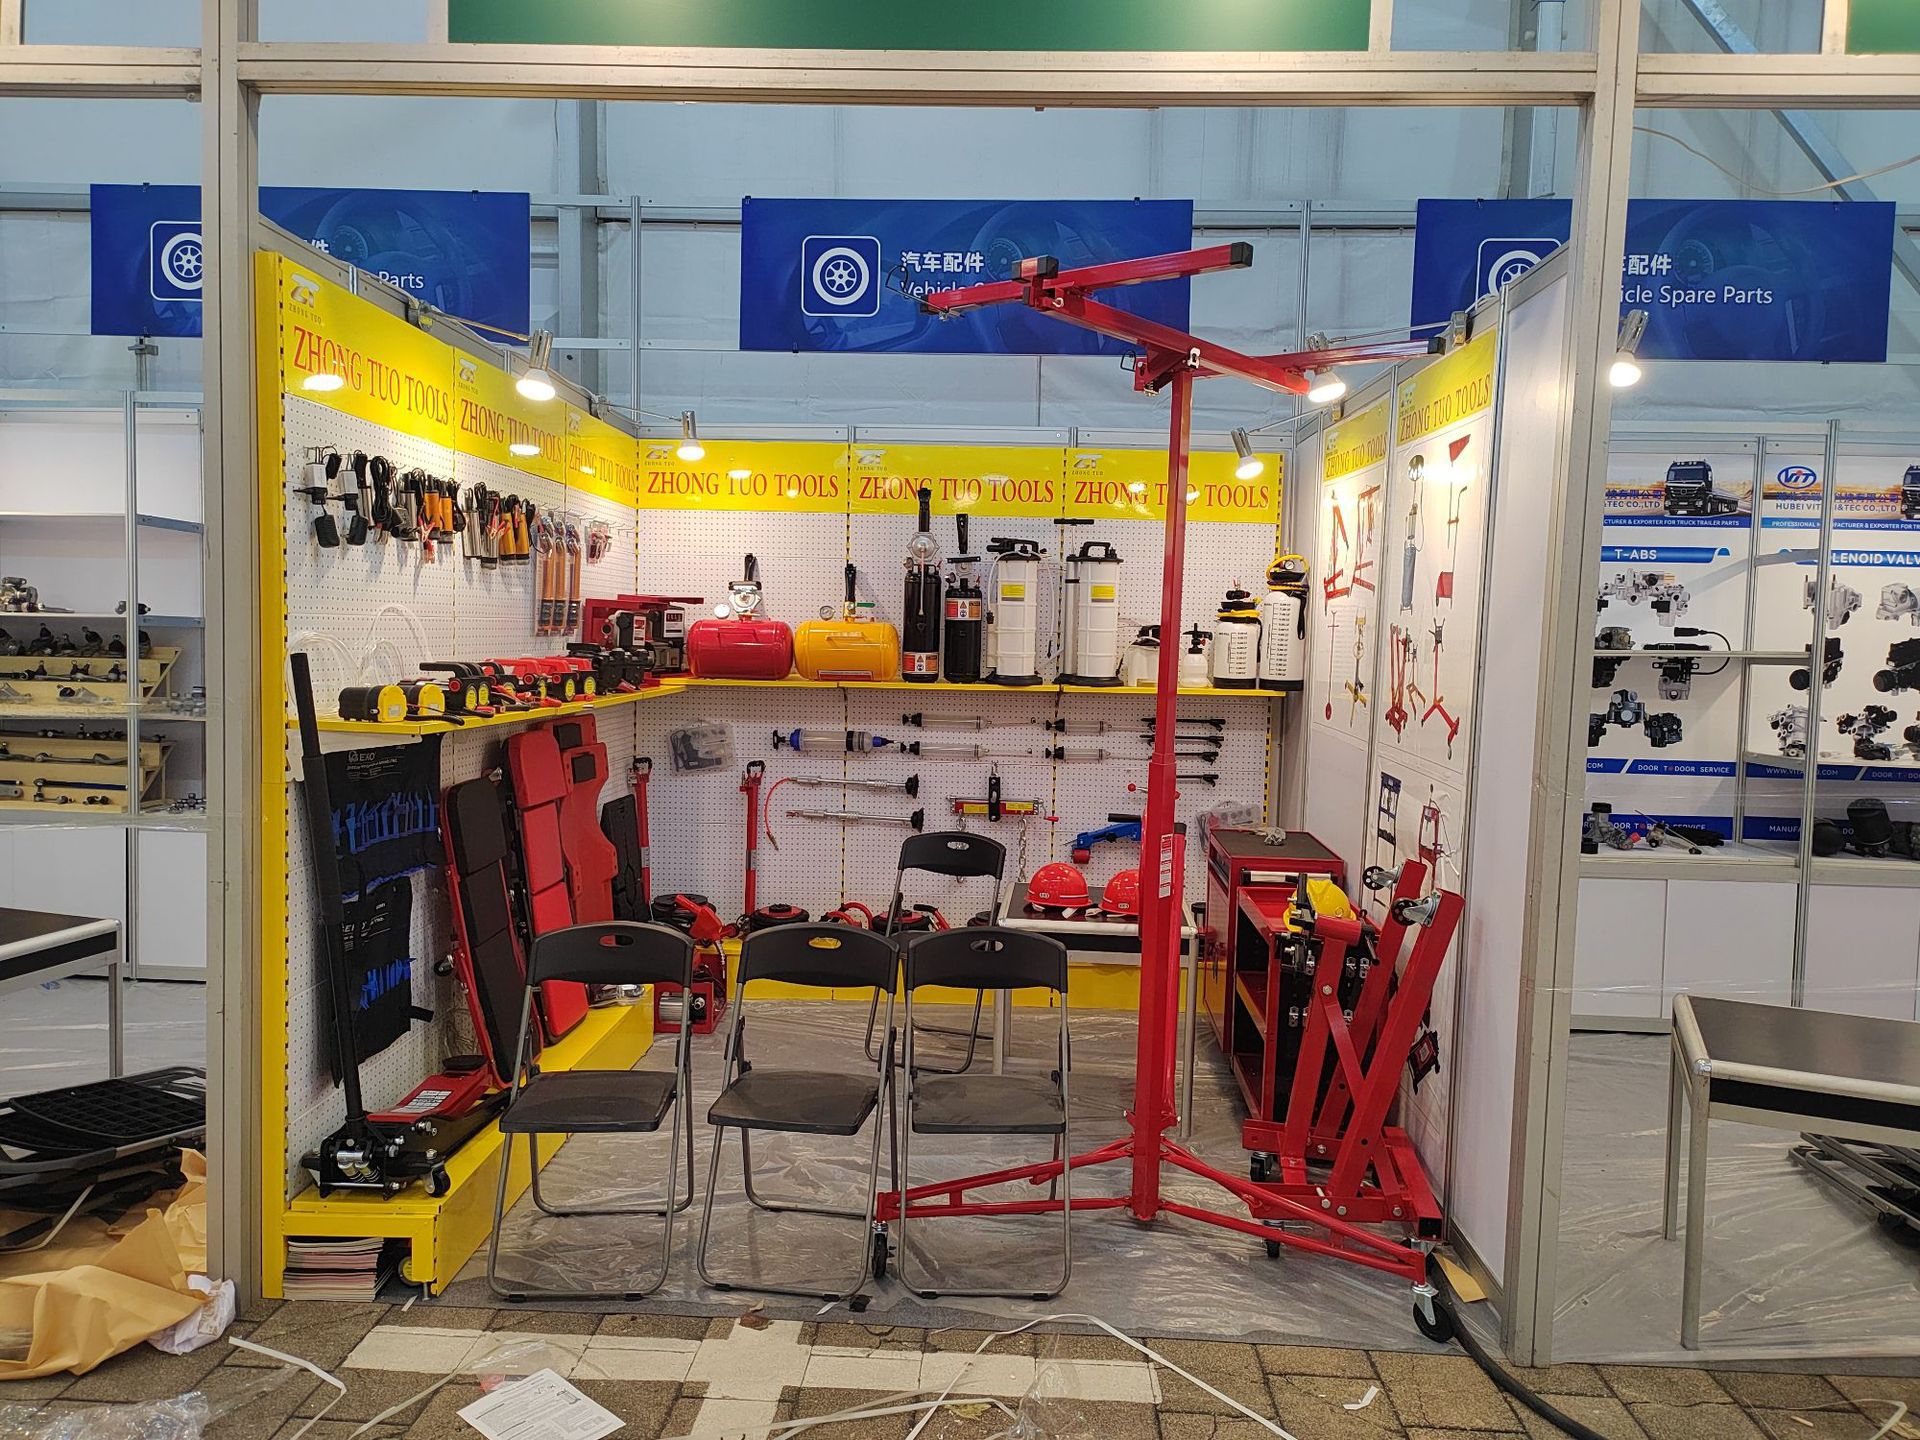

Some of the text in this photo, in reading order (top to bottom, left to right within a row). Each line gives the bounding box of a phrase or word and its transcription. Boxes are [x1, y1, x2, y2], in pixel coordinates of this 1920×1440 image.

[901, 251, 984, 273] 汽车配件
[1622, 254, 1672, 276] 配件
[901, 281, 965, 298] Vehicl
[1659, 285, 1716, 308] Spare
[1723, 286, 1773, 304] Parts
[293, 325, 449, 426] ZHONG TUO TOOLS
[1400, 373, 1491, 442] ZHONG TUO TOOLS
[460, 398, 562, 465] ZHONG TUO TOOLS
[569, 443, 597, 478] ZHONG
[1326, 450, 1349, 478] ZHONG
[1351, 443, 1365, 469] TUO
[647, 471, 839, 498] ZHONG TUO TOOLS
[939, 477, 982, 503] TUO
[988, 478, 1054, 504] TOOLS
[1074, 480, 1270, 509] ZHONG TO TOOLS
[1775, 503, 1821, 511] HUBEI VIT
[1614, 548, 1657, 560] T-ABS
[1832, 553, 1883, 565] LENOID
